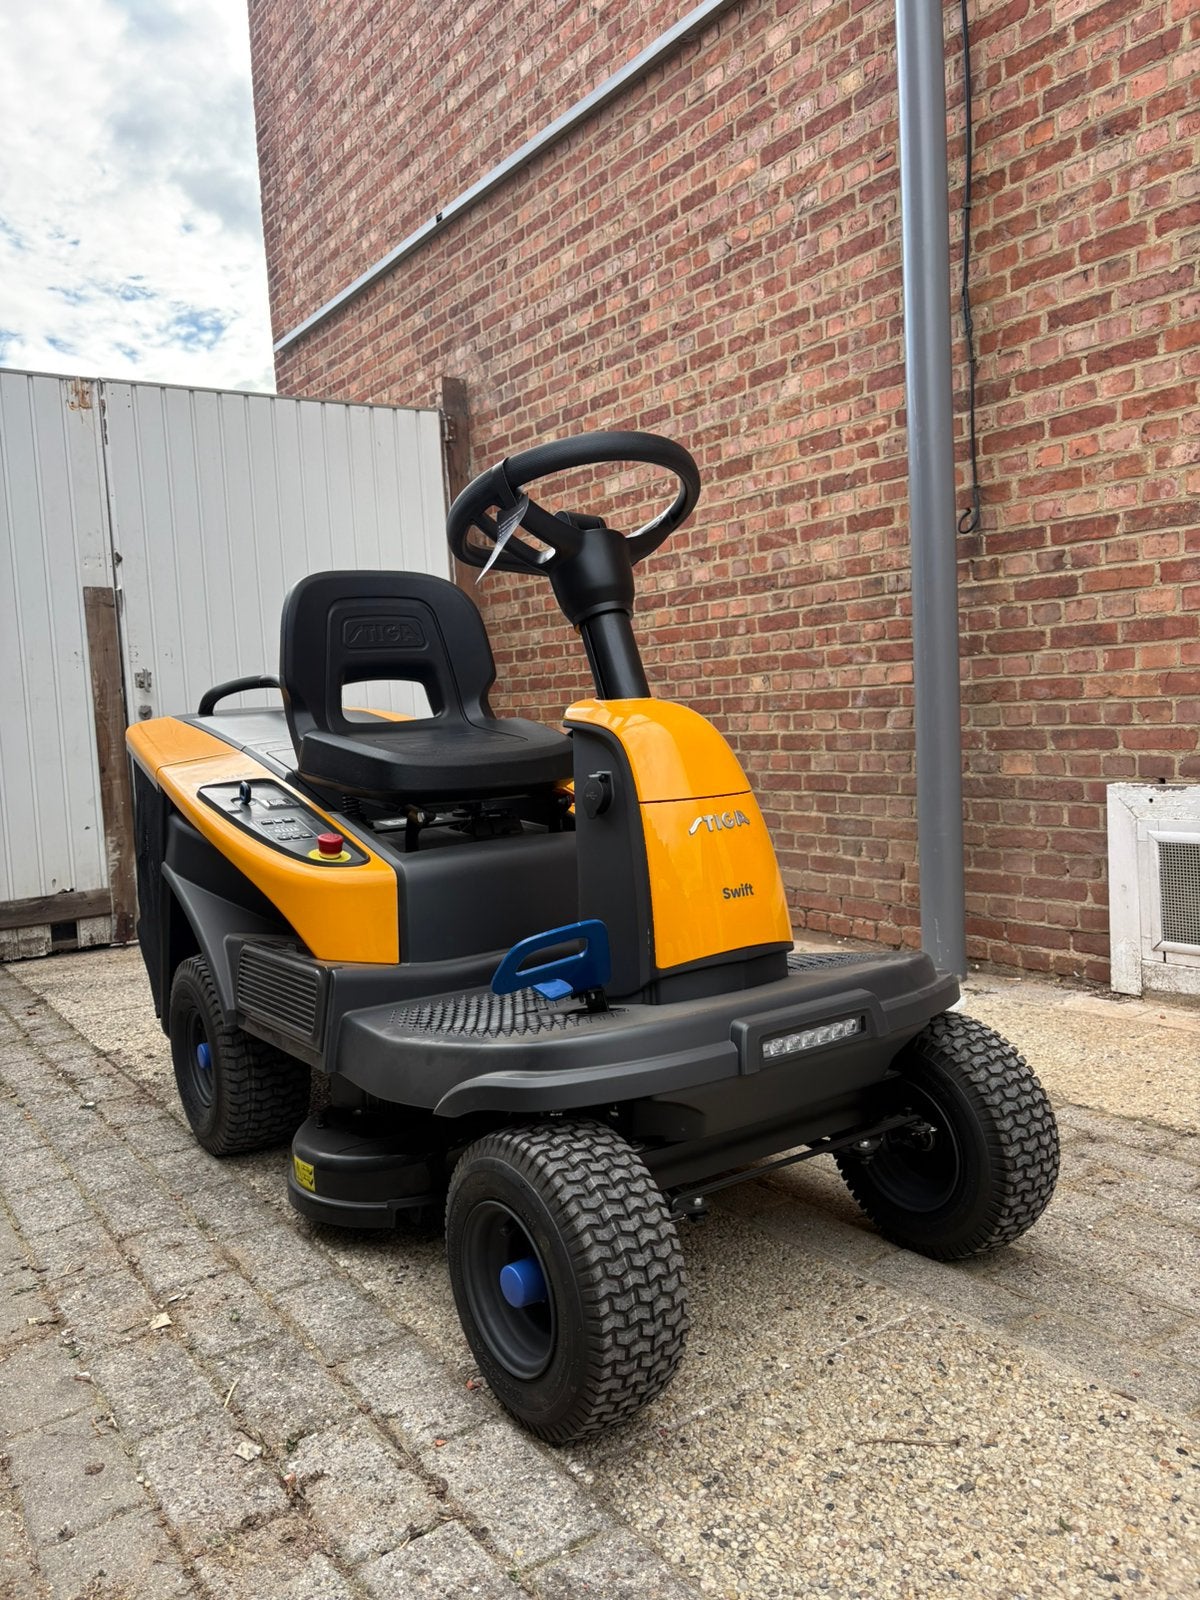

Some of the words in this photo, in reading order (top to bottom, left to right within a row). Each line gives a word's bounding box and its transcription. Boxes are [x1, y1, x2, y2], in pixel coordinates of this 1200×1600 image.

[348, 623, 422, 643] STIGA
[689, 810, 750, 835] STIGA
[722, 883, 754, 899] Swift
